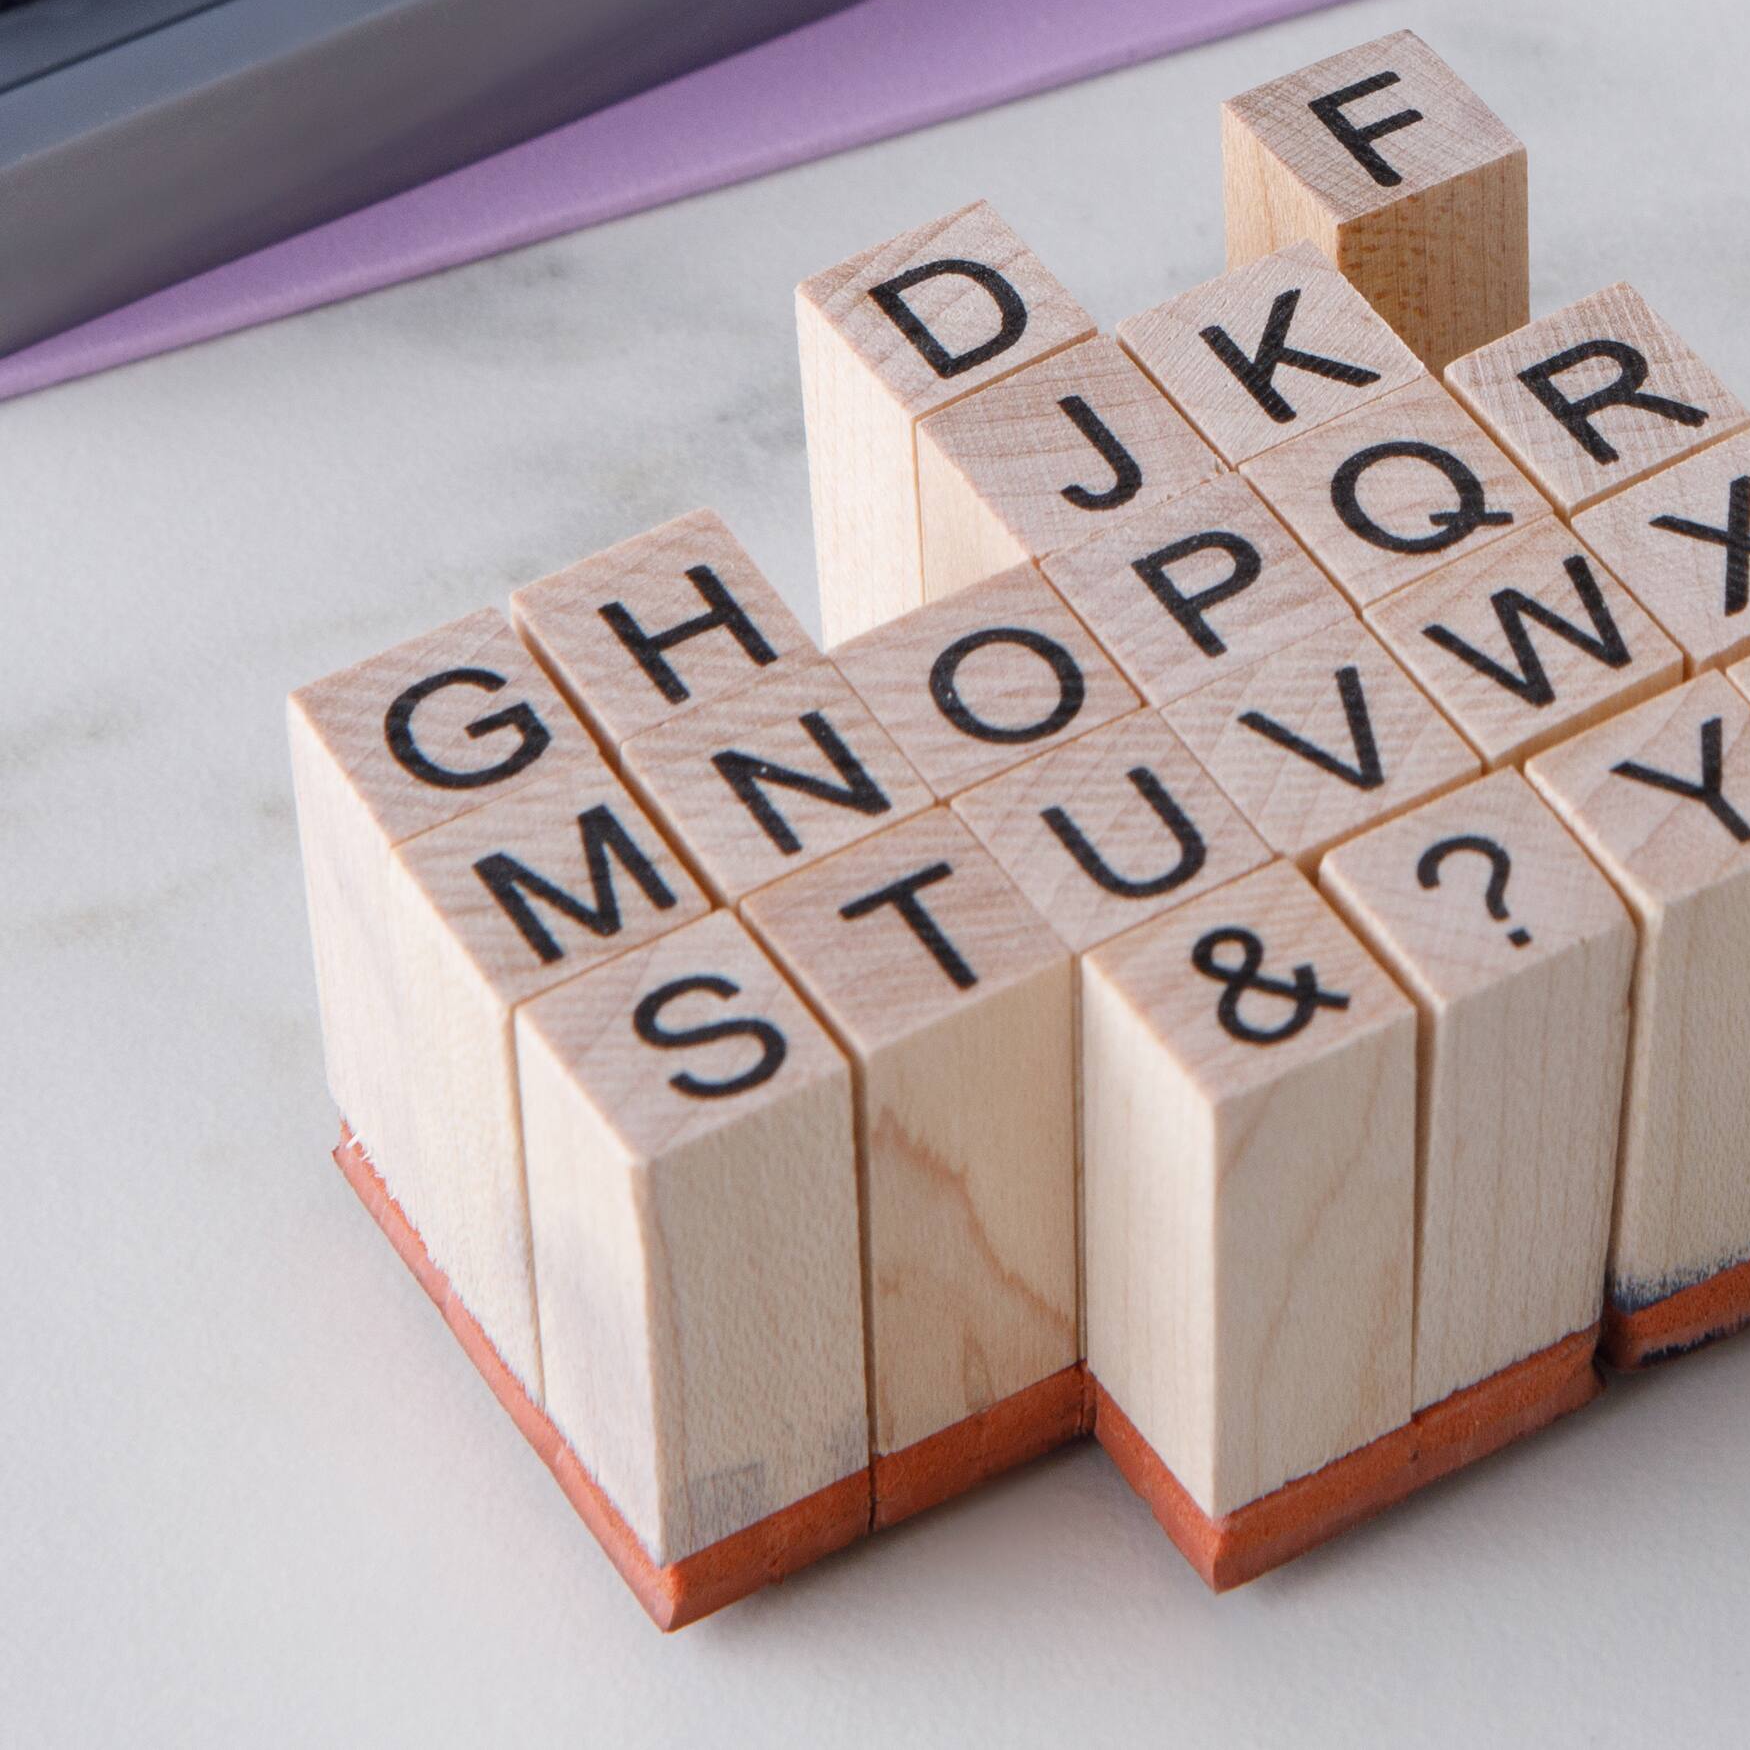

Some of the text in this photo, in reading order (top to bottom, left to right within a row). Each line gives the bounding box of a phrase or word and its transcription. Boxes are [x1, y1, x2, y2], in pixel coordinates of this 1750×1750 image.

[1308, 71, 1423, 187] F
[868, 260, 1027, 379] D
[1199, 289, 1381, 423] K
[1057, 396, 1142, 508] J
[1517, 340, 1709, 465] R
[1331, 442, 1512, 555] Q
[598, 566, 778, 704] H
[1131, 532, 1261, 657] P
[1422, 555, 1632, 707] W
[385, 669, 551, 789] G
[929, 628, 1085, 744] O
[1238, 667, 1384, 790] V
[711, 711, 890, 855] N
[1041, 768, 1206, 898] U
[474, 805, 676, 964] M
[839, 862, 977, 990] T
[1417, 836, 1530, 947] ?
[634, 977, 786, 1099] S
[1192, 928, 1350, 1046] &
